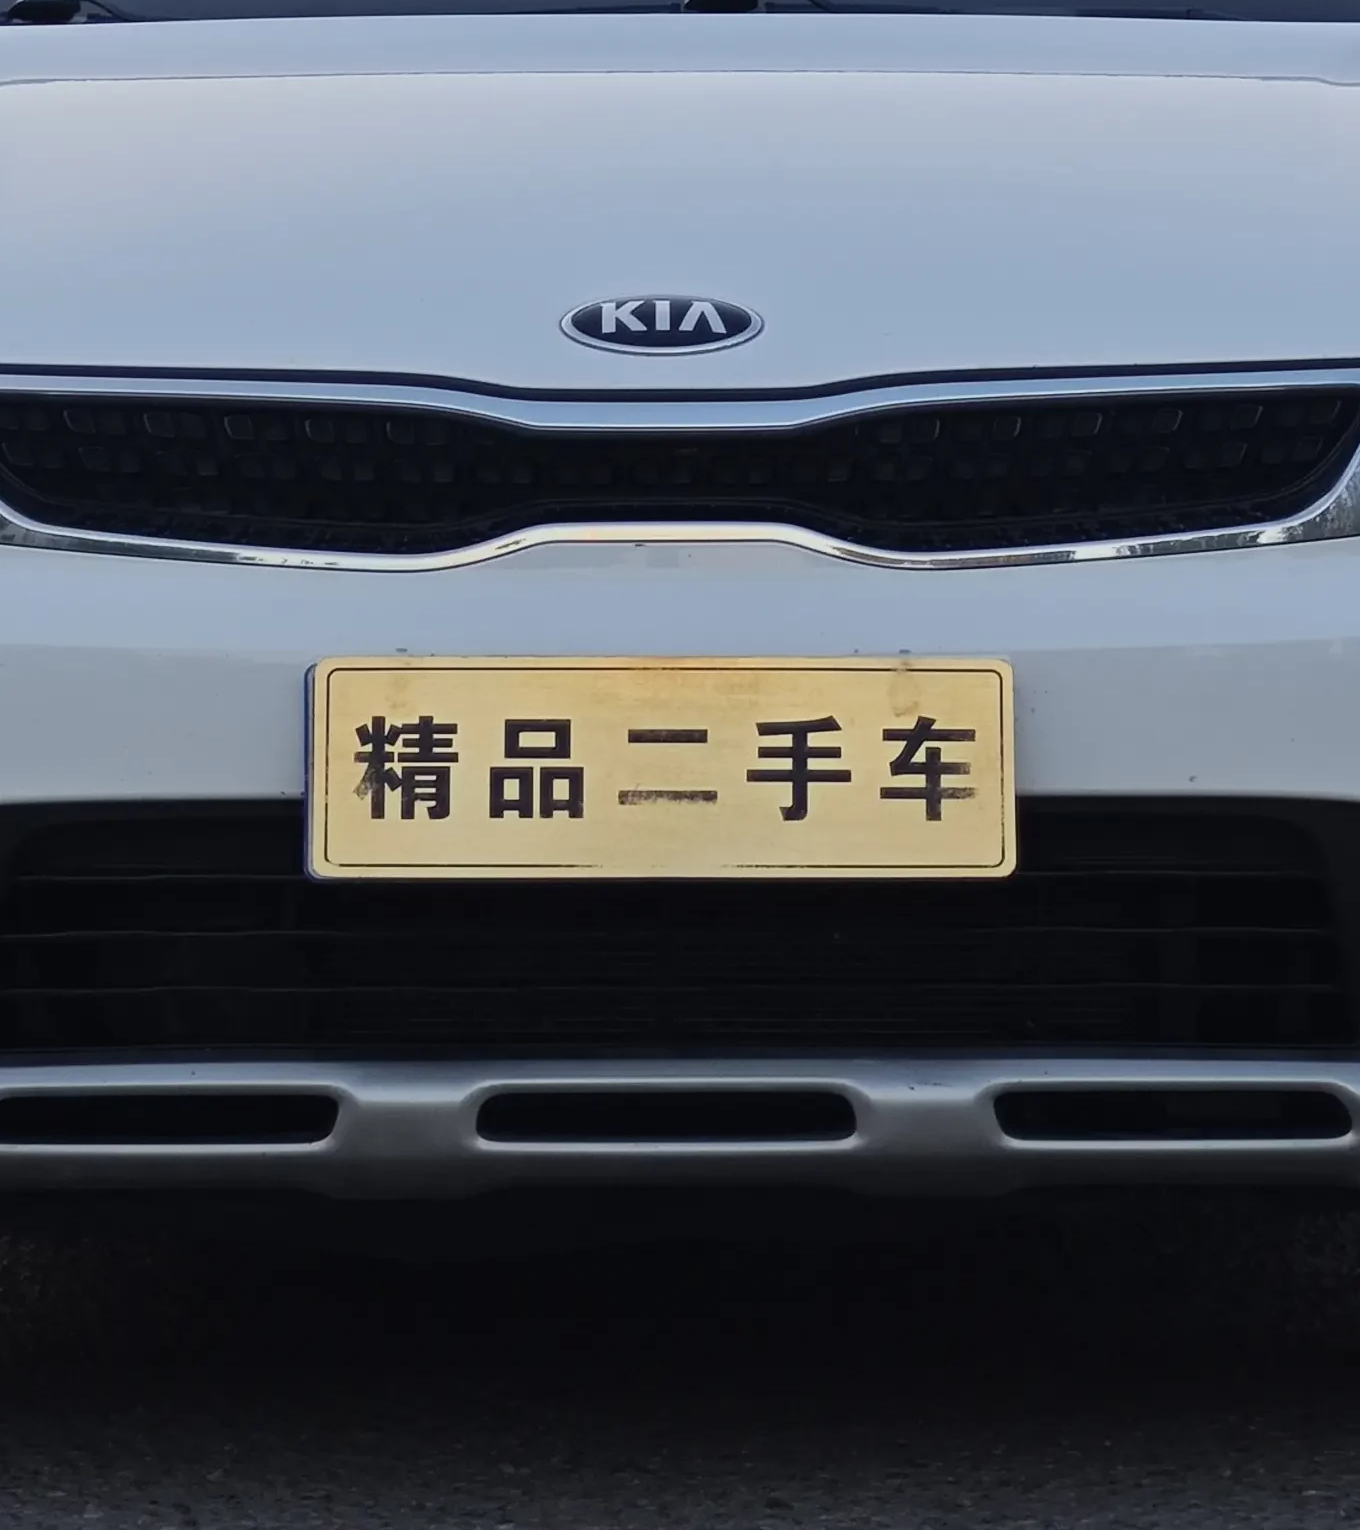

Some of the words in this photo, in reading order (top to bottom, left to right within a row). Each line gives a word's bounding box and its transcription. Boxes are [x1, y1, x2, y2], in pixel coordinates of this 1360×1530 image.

[599, 299, 727, 334] KIA
[353, 715, 977, 822] 精品二手车
